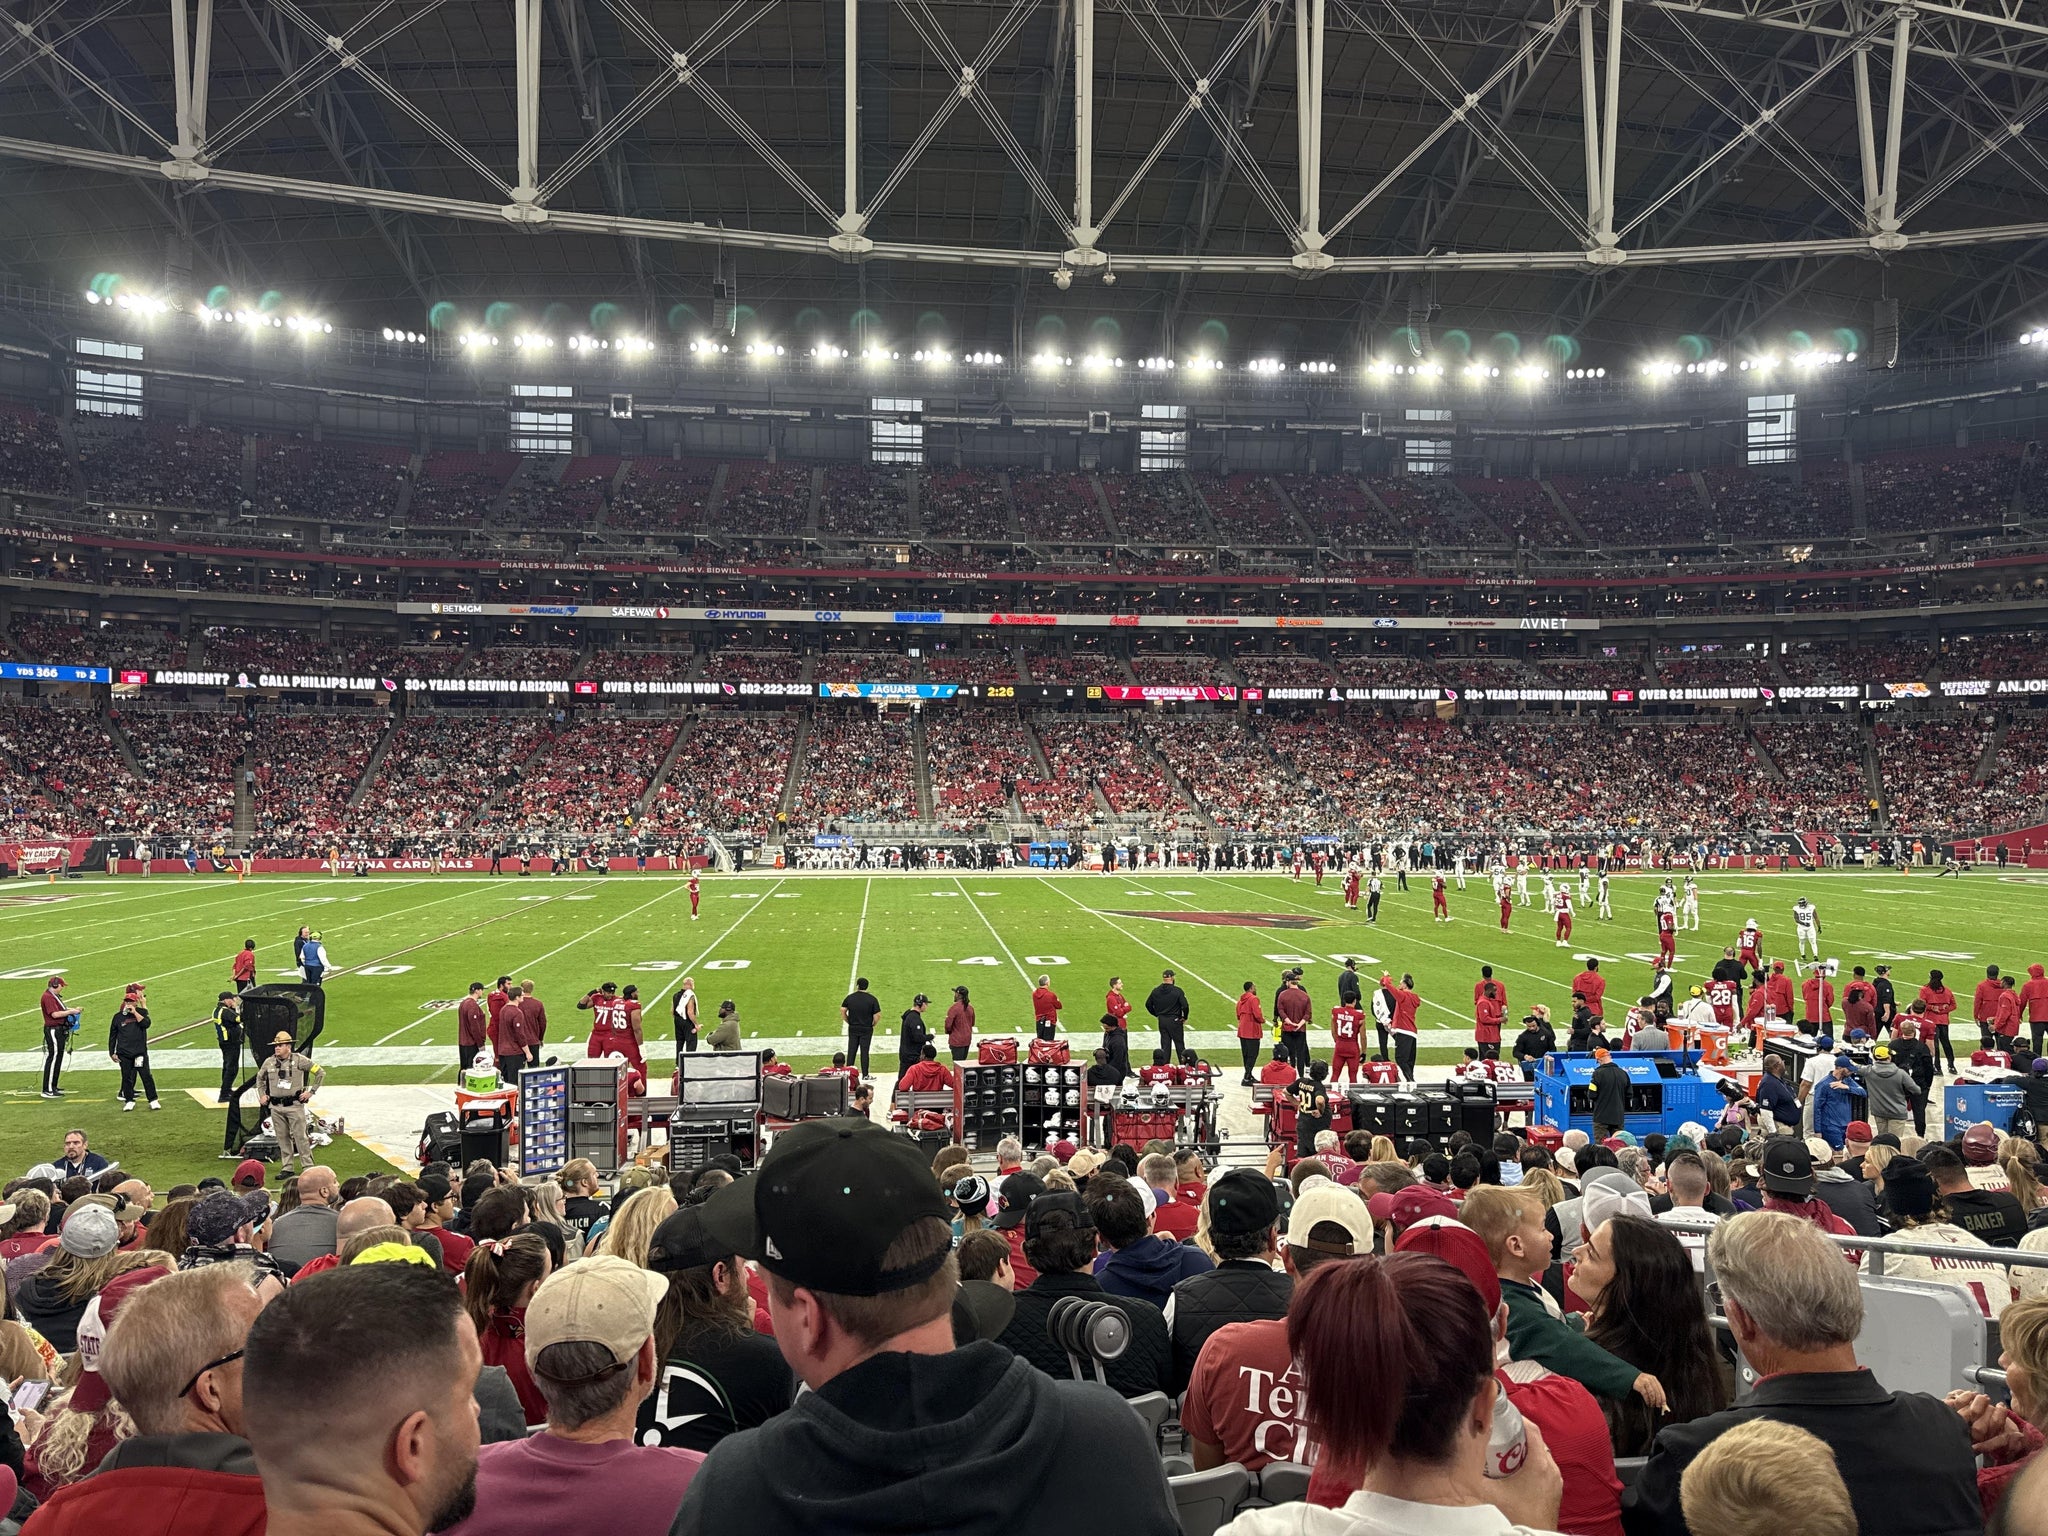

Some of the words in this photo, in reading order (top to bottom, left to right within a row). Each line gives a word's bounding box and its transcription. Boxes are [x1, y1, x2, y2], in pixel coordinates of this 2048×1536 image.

[22, 530, 74, 543] WILLIAMS
[555, 563, 592, 572] BIDWILL,
[1903, 564, 1937, 574] ADRIAN
[1940, 562, 1975, 571] WILSON
[443, 604, 482, 613] BETMGM
[611, 607, 656, 617] SAFEWAY
[722, 611, 767, 619] HYUNDAI
[815, 612, 842, 621] COX
[895, 613, 915, 622] BUD
[1519, 618, 1568, 629] AVNET
[17, 667, 35, 676] YDS
[36, 667, 59, 678] 366
[75, 671, 87, 679] TD
[90, 671, 97, 679] 2
[155, 670, 230, 687] ACCIDENT?
[259, 674, 291, 688] CALL
[291, 675, 349, 689] PHILLIPS
[349, 676, 377, 689] LAW
[404, 679, 428, 691] 30+
[428, 679, 466, 692] YEARS
[467, 680, 518, 692] SERVING
[519, 680, 570, 693] ARIZONA
[1940, 680, 1991, 690] DEFENSIVE
[602, 682, 632, 694] OVER
[633, 682, 648, 694] $2
[648, 682, 693, 694] BILLION
[693, 682, 720, 695] WON
[869, 685, 918, 694] JAGUARS
[931, 686, 940, 696] 7
[972, 687, 979, 697] 1
[987, 687, 1015, 697] 2:26
[1089, 688, 1101, 697] 25
[1121, 688, 1130, 698] 7
[1141, 688, 1199, 697] CARDINALS
[1267, 688, 1325, 700] ACCIDENT?
[1346, 688, 1372, 700] CALL
[1372, 689, 1418, 700] PHILLIPS
[1418, 689, 1441, 700] LAW
[1638, 688, 1668, 700] OVER
[1669, 688, 1684, 700] $2
[1685, 688, 1730, 700] BILLION
[1730, 687, 1758, 699] WON
[1944, 688, 1987, 697] LEADERS
[1464, 689, 1485, 701] 30+
[1486, 689, 1519, 701] YEARS
[1520, 689, 1564, 701] SERVING
[1564, 690, 1608, 701] ARIZONA
[34, 849, 57, 858] CAUSE
[321, 860, 387, 869] AIZNA
[392, 860, 474, 869] CARDNALS
[1798, 912, 1812, 921] 85
[1742, 935, 1755, 947] 16
[1710, 989, 1732, 1006] 28
[595, 1010, 609, 1025] 71
[612, 1009, 628, 1029] 66
[1336, 1021, 1354, 1038] 14
[1715, 1037, 1727, 1049] G
[1152, 1072, 1169, 1080] KNIGHT
[1328, 1154, 1349, 1165] SINCE
[1963, 1211, 2006, 1231] BAKER
[80, 1334, 101, 1357] STATE
